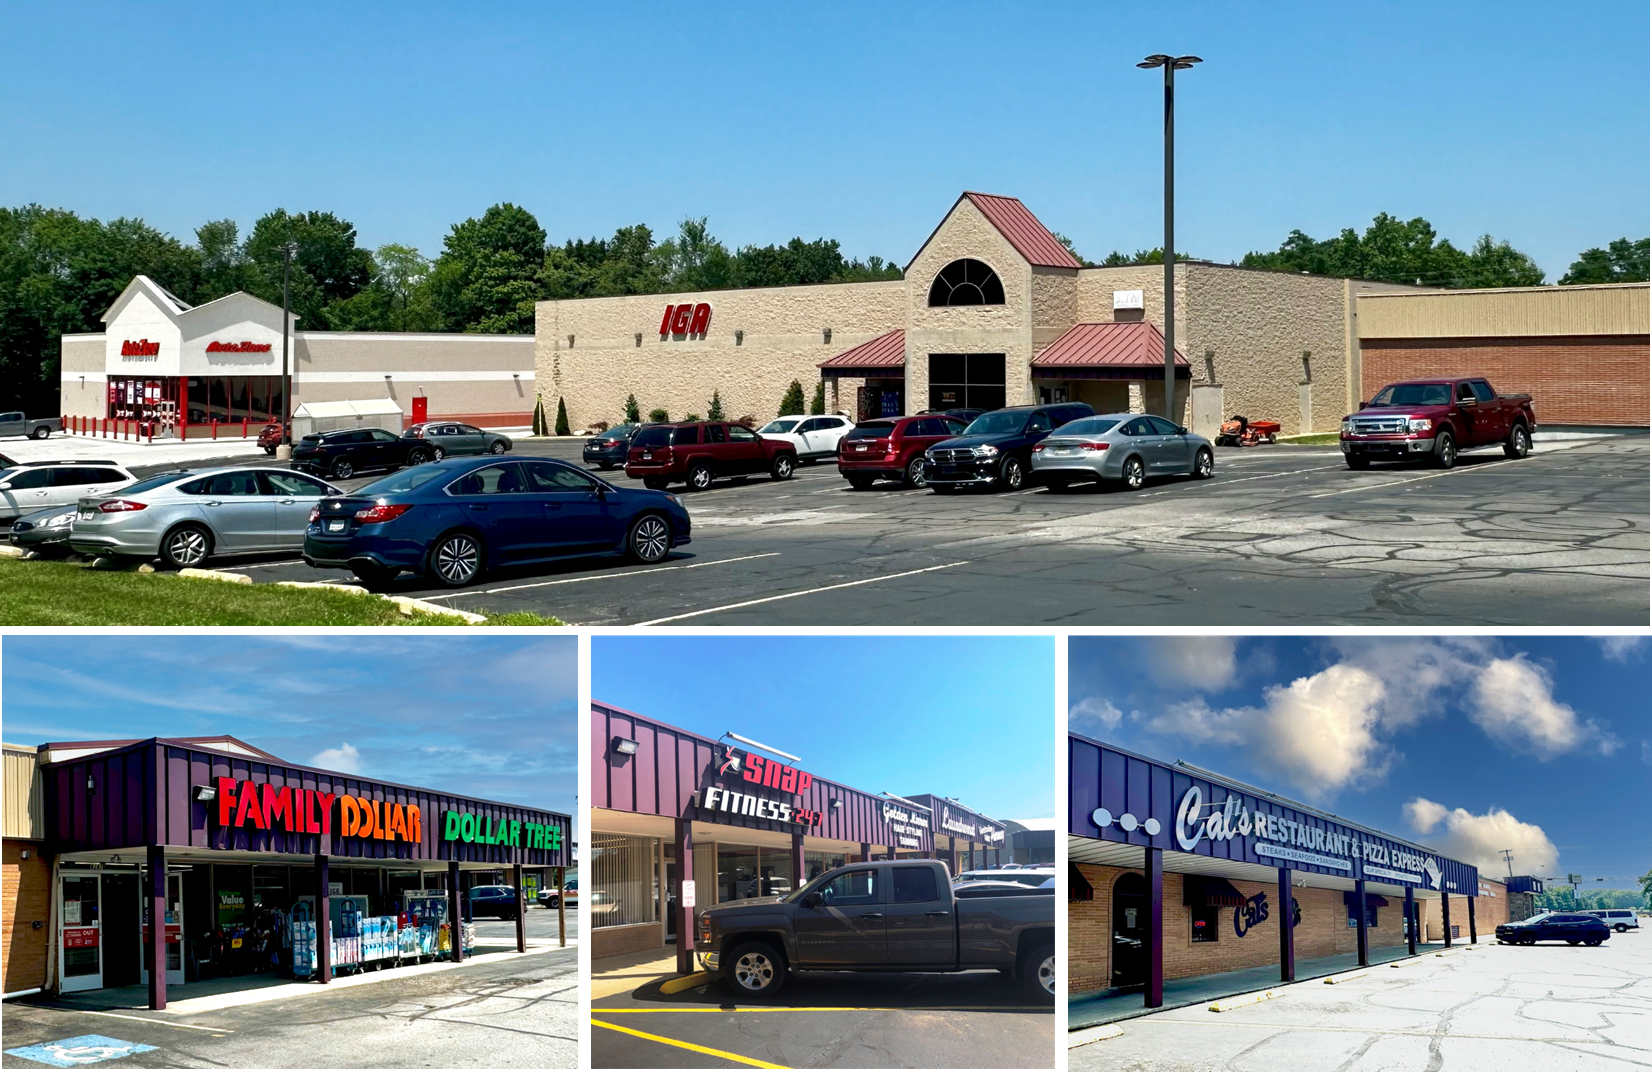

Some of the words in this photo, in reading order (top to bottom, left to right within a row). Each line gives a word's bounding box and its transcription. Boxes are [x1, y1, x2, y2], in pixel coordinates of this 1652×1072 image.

[659, 303, 713, 335] IGA
[218, 775, 336, 835] FAMILY
[340, 794, 421, 843] DOLLAR
[704, 786, 791, 822] FITNESS
[444, 810, 521, 847] DOLLAR
[525, 822, 561, 850] TREE
[1175, 785, 1253, 850] Cal's
[1254, 810, 1352, 857] RESTAURANT
[1351, 837, 1360, 858] &
[1362, 841, 1391, 866] PIZZA
[1392, 849, 1425, 873] EXPRESS
[1261, 846, 1287, 857] STEAKS
[1290, 851, 1316, 863] SEAFOOD
[1320, 857, 1349, 869] SANDWICHES
[221, 895, 244, 905] Value
